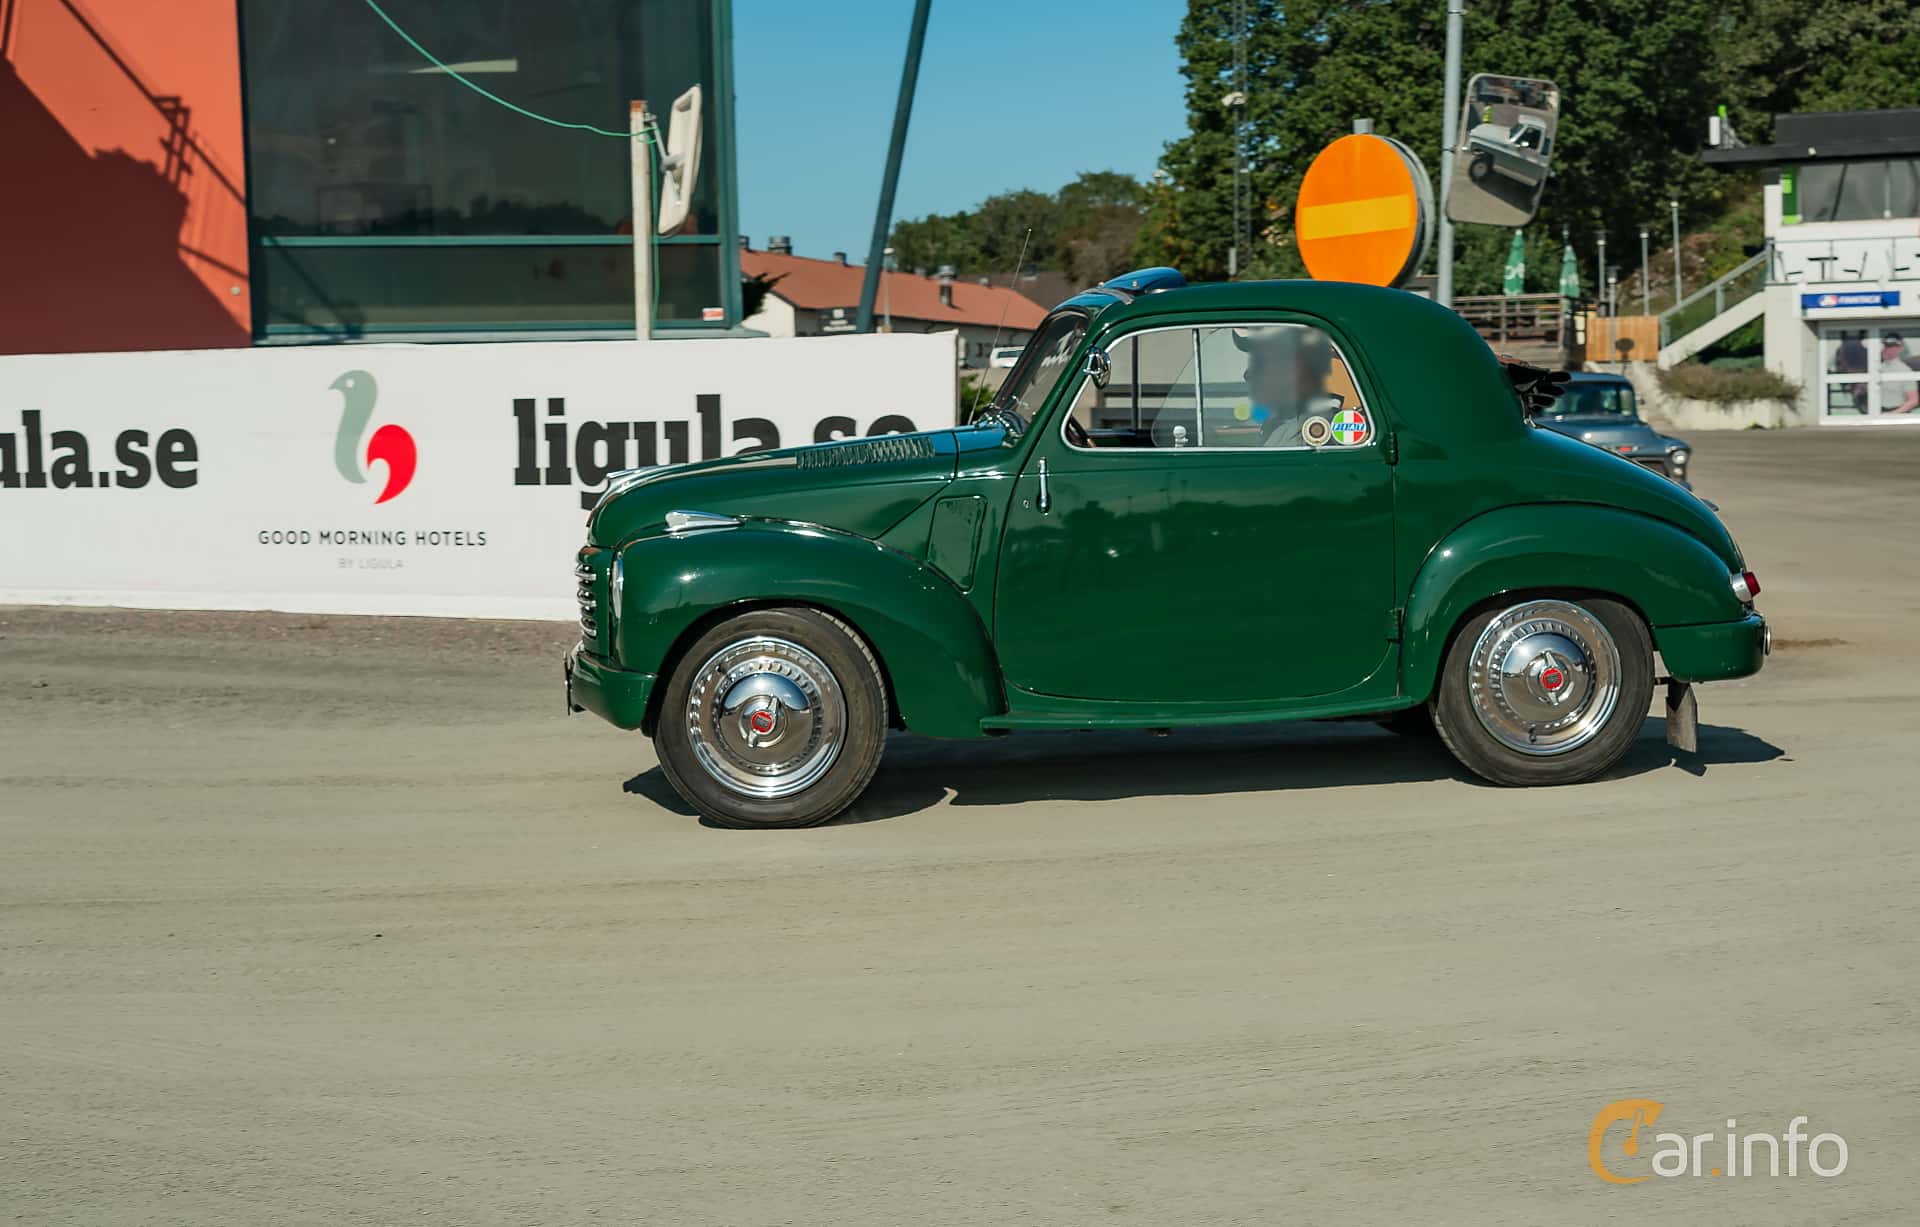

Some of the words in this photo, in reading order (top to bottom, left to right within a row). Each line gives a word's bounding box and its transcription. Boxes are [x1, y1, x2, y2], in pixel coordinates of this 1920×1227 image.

[513, 394, 919, 511] ligula
[258, 530, 311, 545] GOOD
[318, 531, 407, 546] MORNING
[414, 531, 487, 546] HOTELS
[338, 558, 353, 569] BY
[358, 558, 405, 569] LIGULA
